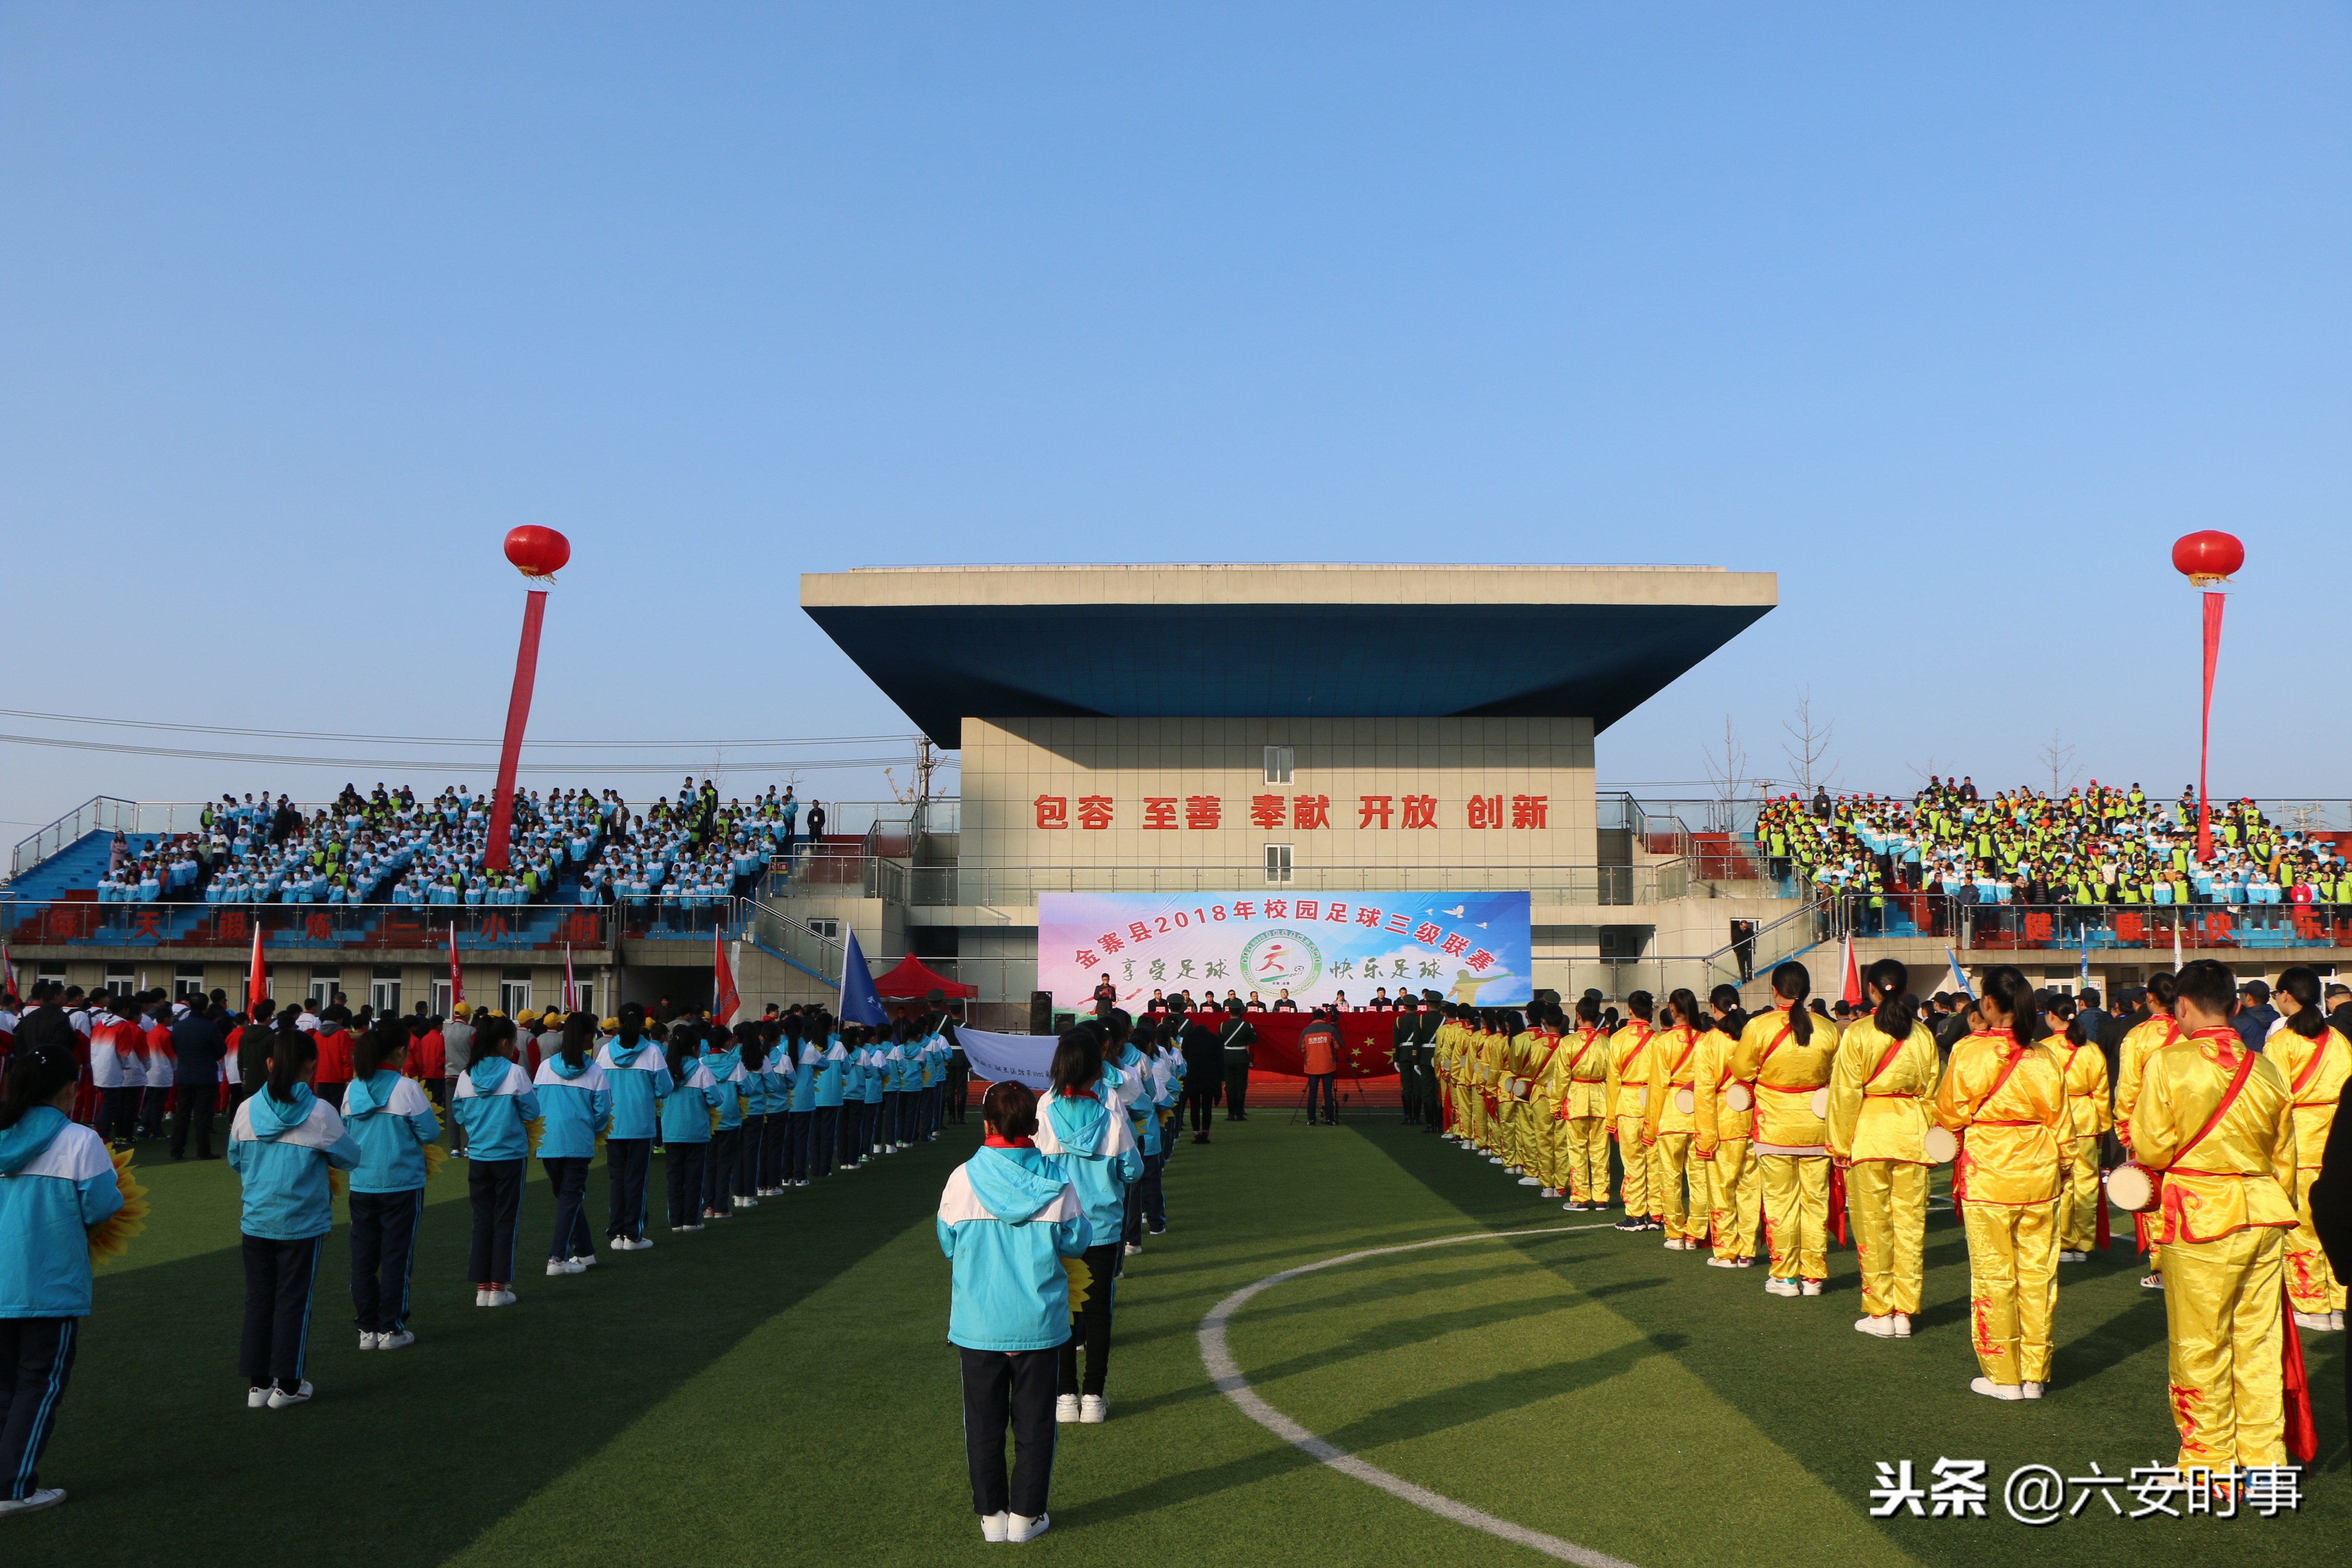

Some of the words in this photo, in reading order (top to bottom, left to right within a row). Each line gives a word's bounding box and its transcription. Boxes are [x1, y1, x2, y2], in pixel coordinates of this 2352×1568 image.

[1034, 794, 1113, 829] 包容
[1143, 795, 1221, 830] 至善
[1251, 794, 1329, 829] 奉献
[1359, 794, 1437, 829] 开放
[1467, 794, 1548, 829] 创新
[50, 910, 599, 942] 每天锻炼一小时
[1075, 899, 1496, 972] 金寨县2018年校园足球三级联赛
[2023, 912, 2324, 941] 健康快乐
[1121, 958, 1230, 982] 享受足球
[1329, 958, 1443, 980] 快乐足球
